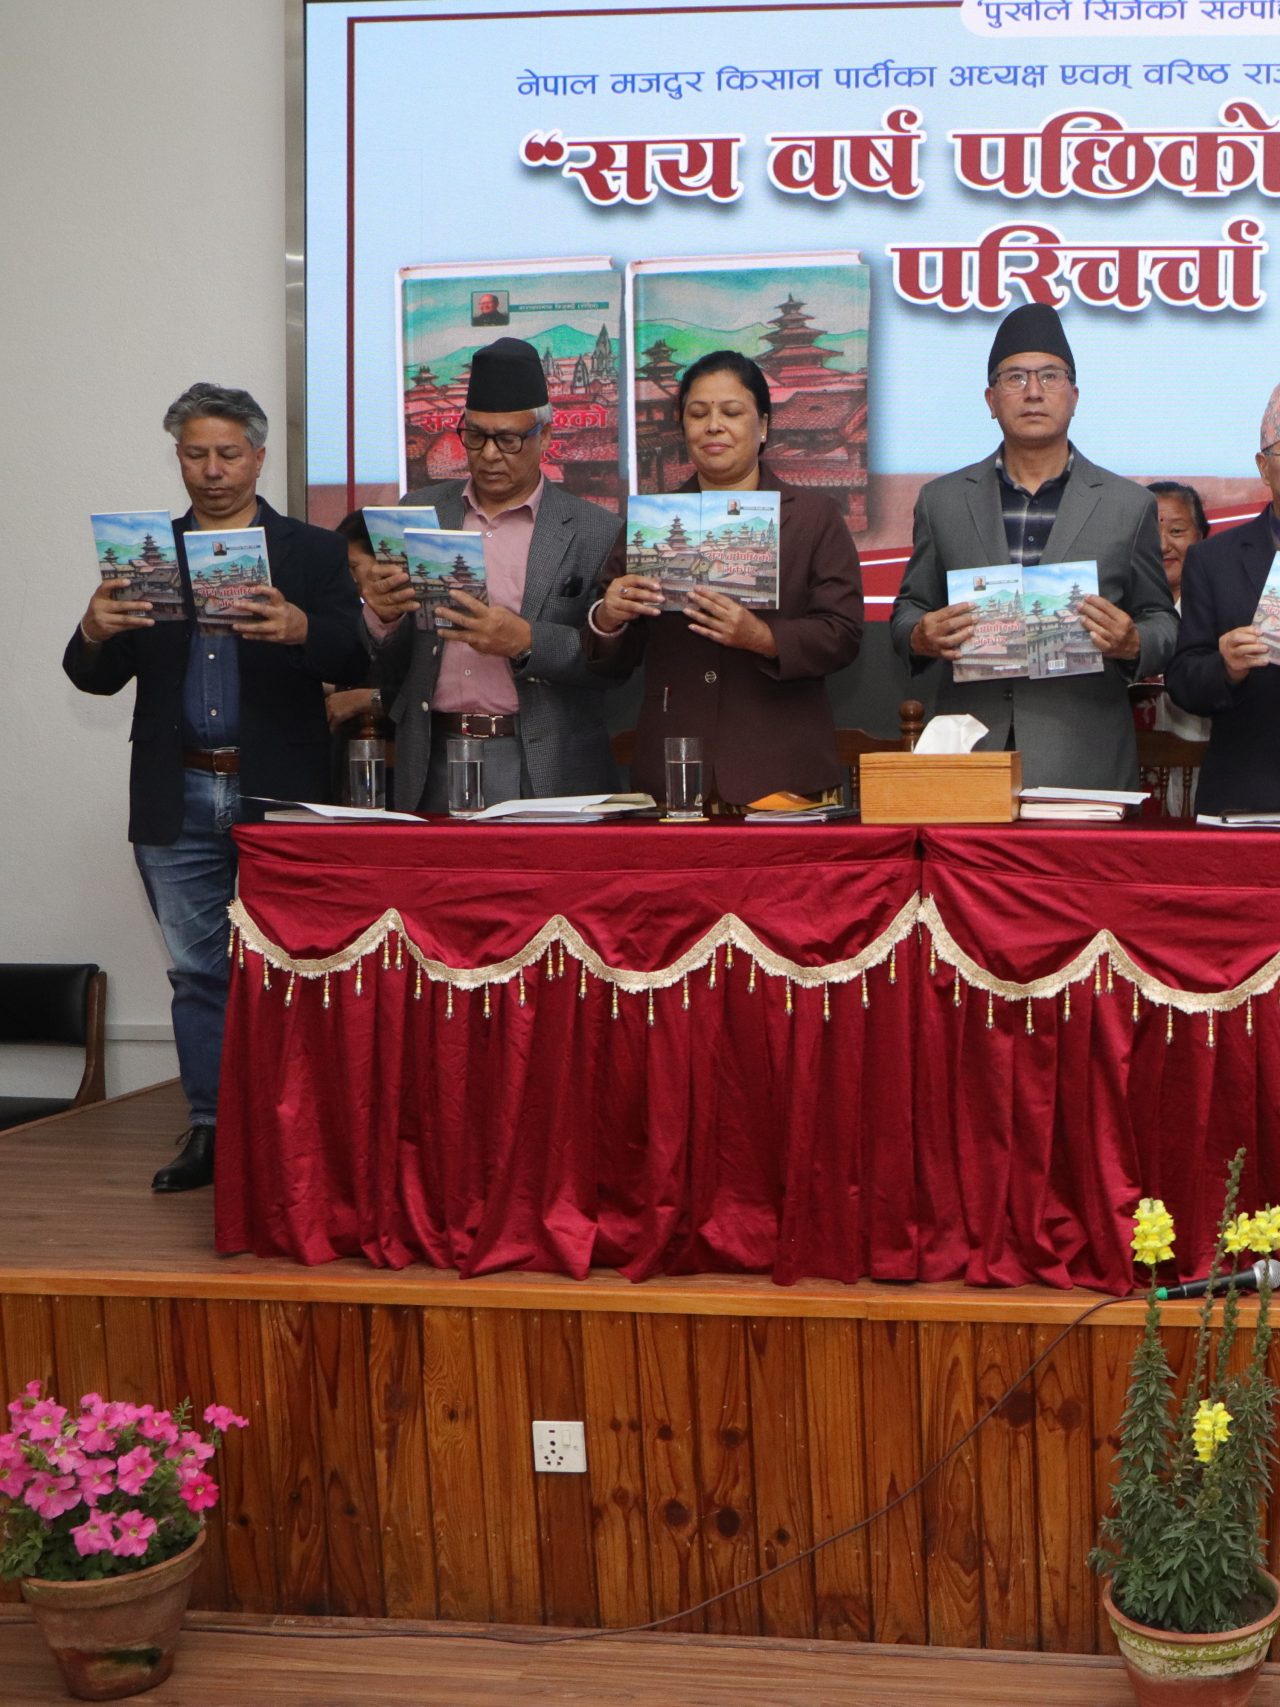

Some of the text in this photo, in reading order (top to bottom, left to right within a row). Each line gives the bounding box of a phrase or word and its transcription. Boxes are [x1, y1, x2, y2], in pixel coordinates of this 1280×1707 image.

[516, 69, 599, 97] नेपाल
[610, 71, 705, 100] मजदुर
[716, 65, 823, 92] किसान
[834, 59, 938, 89] पार्टीका
[949, 64, 1048, 88] अध्यक्ष
[1060, 63, 1133, 90] एवम्
[1143, 59, 1231, 86] वरिष्ठ
[771, 109, 924, 197] वर्ष
[889, 220, 1264, 310] परिचर्चा
